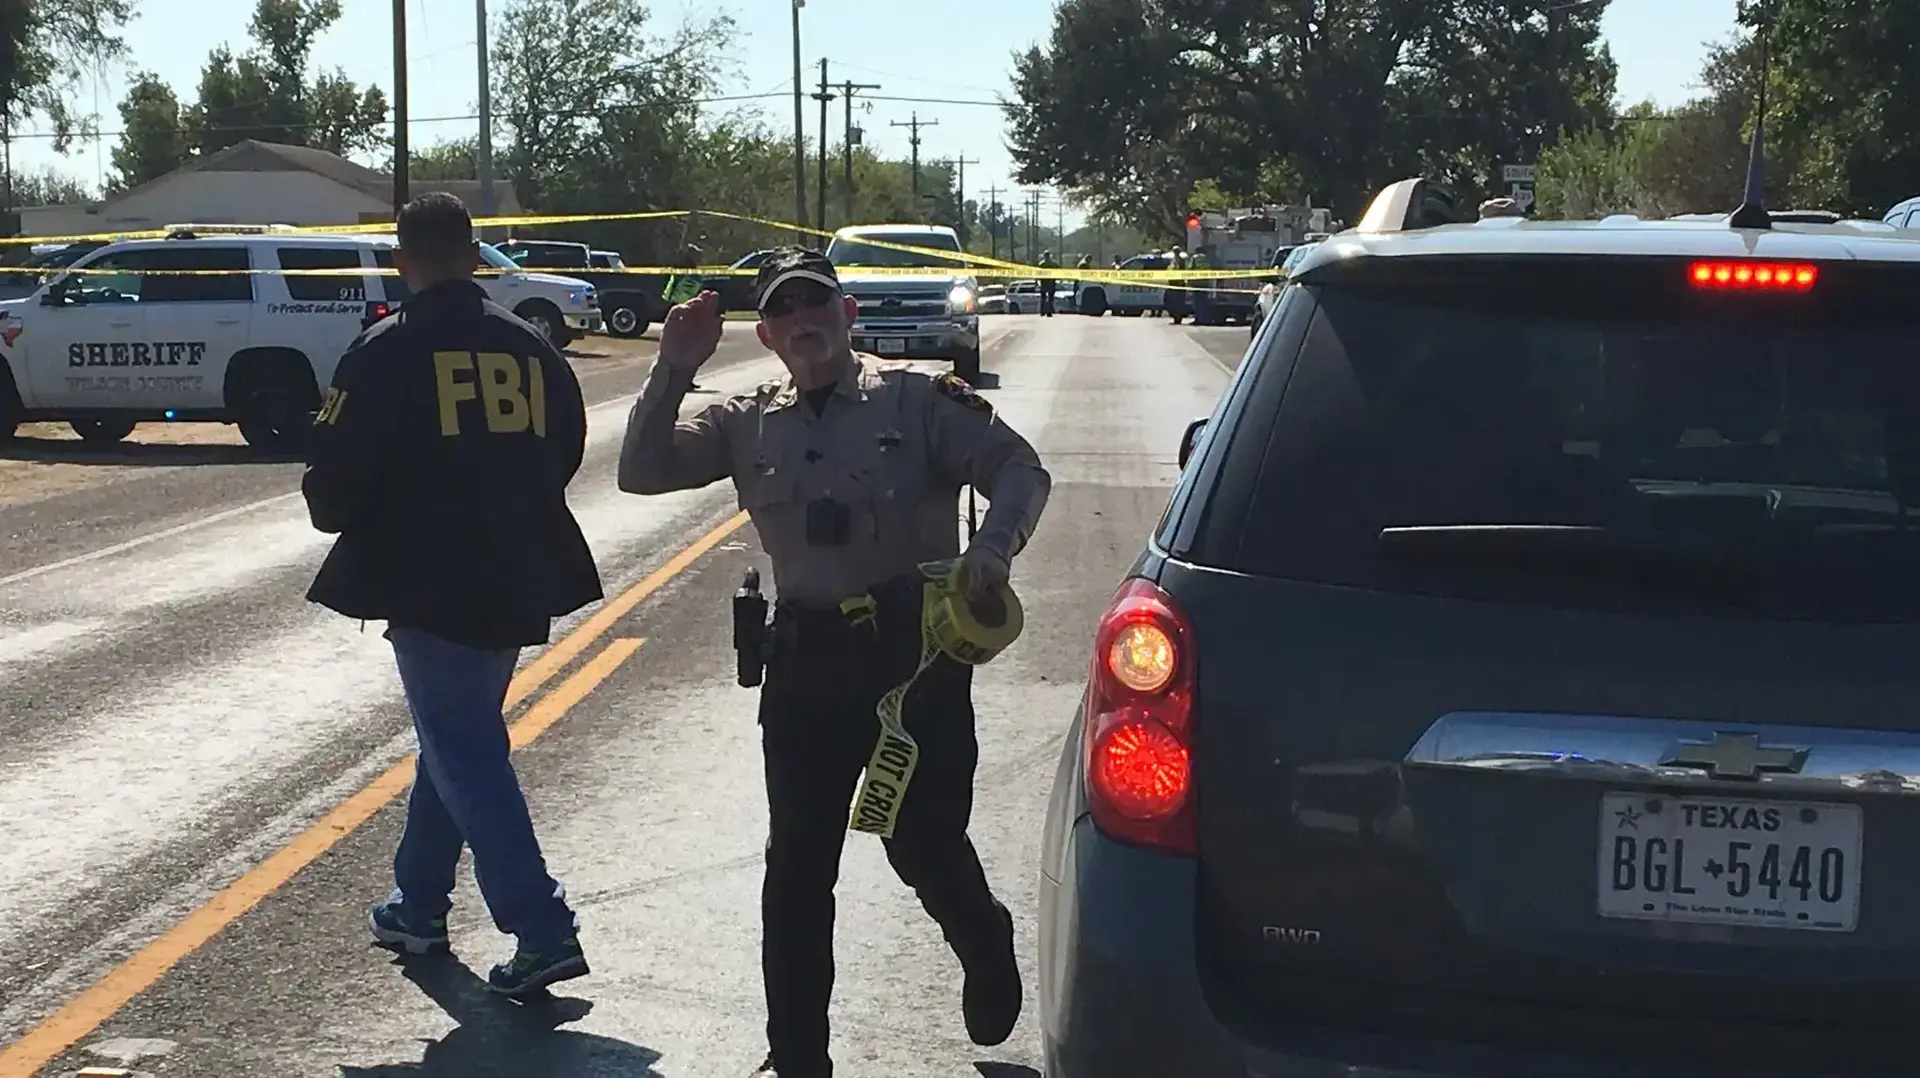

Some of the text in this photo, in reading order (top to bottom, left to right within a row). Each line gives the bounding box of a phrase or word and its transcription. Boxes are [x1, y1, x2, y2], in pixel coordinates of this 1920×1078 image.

[339, 287, 364, 300] 911
[68, 341, 206, 367] SHERIFF
[313, 387, 348, 426] BI
[433, 351, 546, 438] FBI
[876, 734, 913, 782] NOT
[1681, 804, 1782, 832] TEXAS
[1612, 835, 1844, 903] BGL 5440
